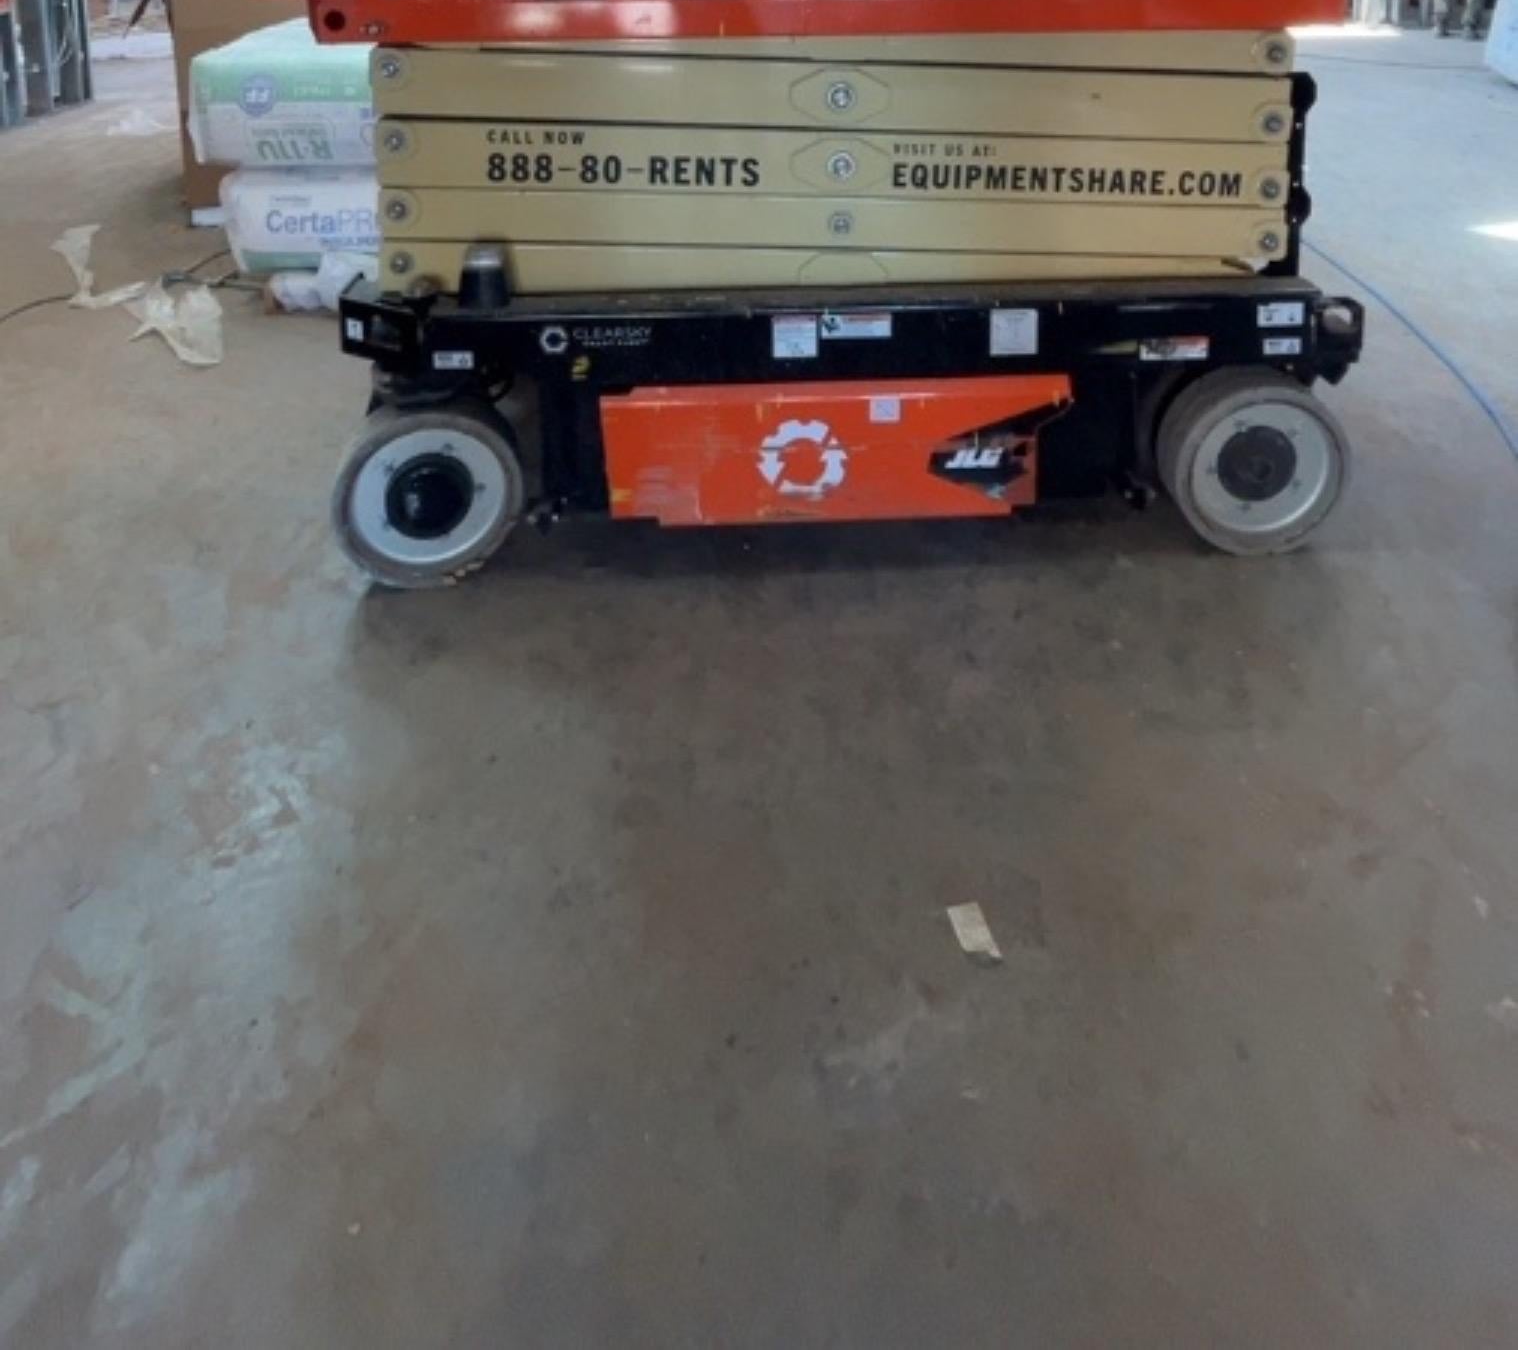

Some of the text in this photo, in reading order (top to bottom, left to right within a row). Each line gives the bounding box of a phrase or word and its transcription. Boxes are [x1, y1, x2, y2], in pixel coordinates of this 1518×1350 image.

[486, 129, 585, 146] CALL NOW
[944, 143, 964, 156] US
[487, 153, 760, 187] 888-80-RENTS
[892, 162, 1242, 198] EQUIPMENTSHARE.COM
[266, 208, 379, 234] CertaPR
[572, 326, 652, 340] CLEARSKY
[944, 446, 1004, 469] JLG
